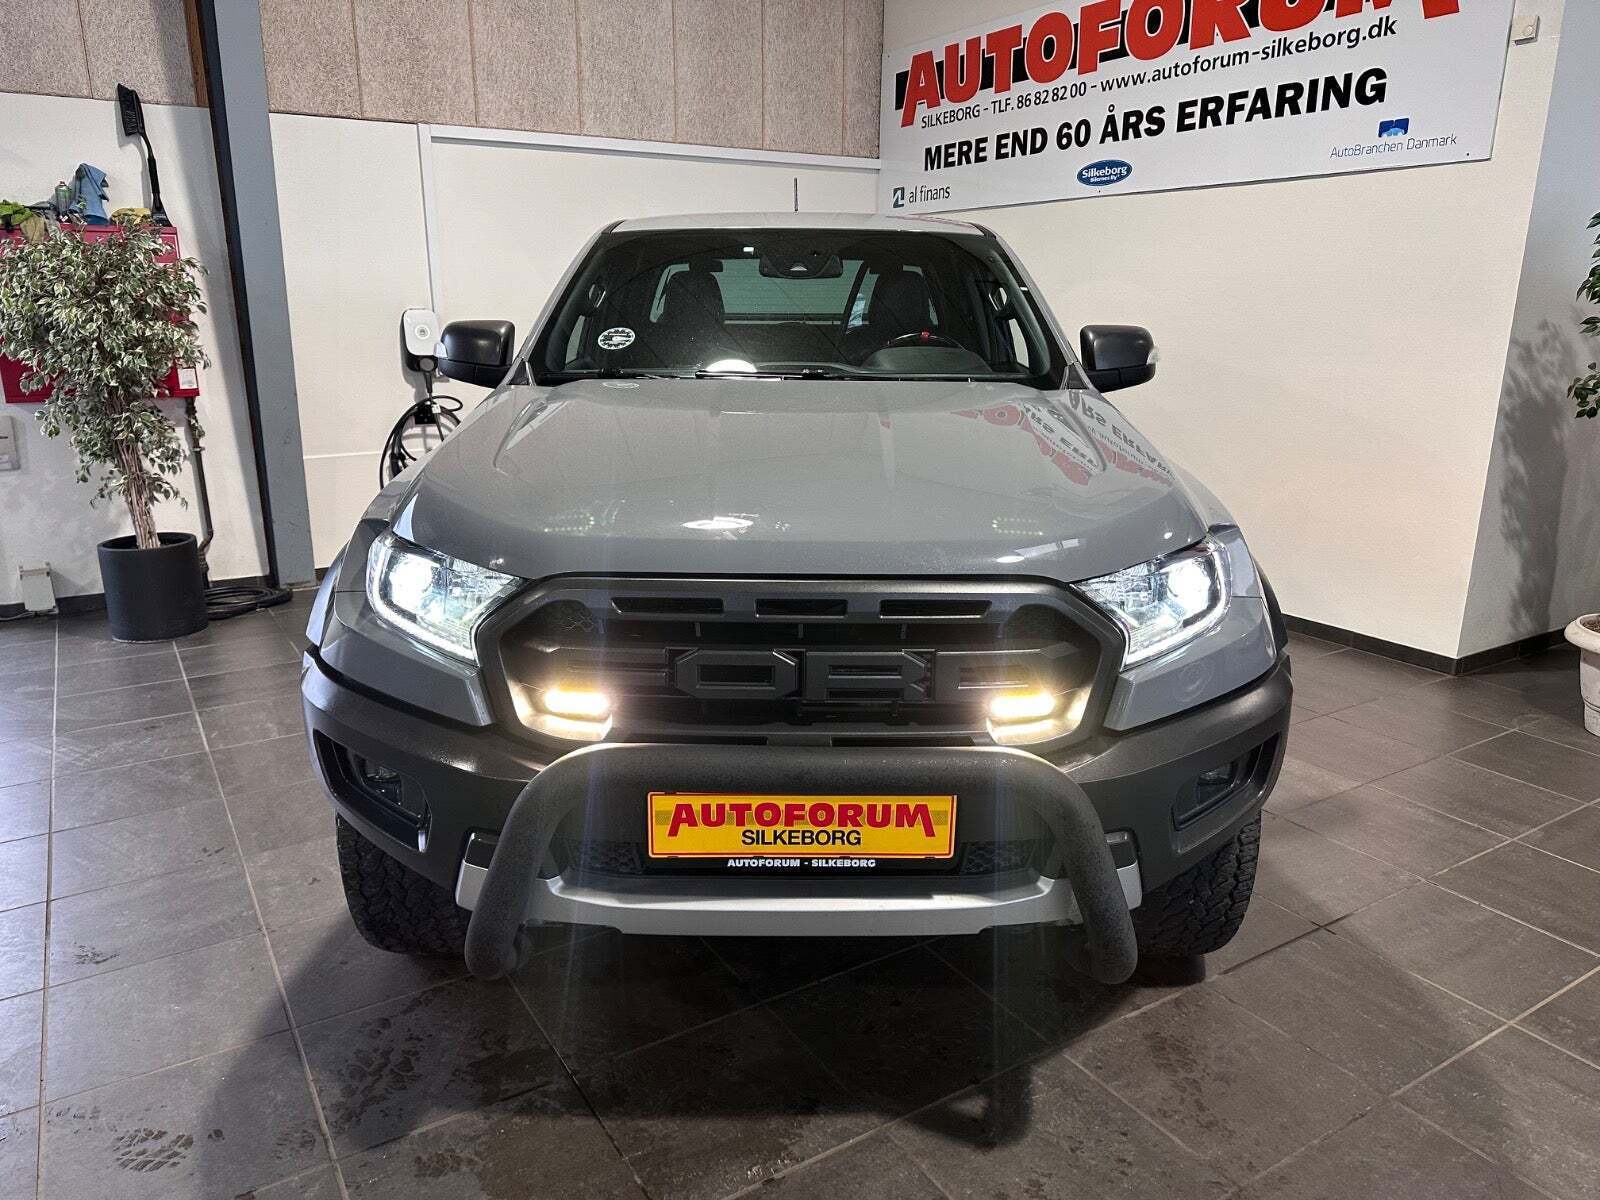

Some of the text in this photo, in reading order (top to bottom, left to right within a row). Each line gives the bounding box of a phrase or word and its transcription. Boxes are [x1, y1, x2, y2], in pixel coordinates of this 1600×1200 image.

[901, 0, 1460, 128] AUTOFOR
[921, 104, 981, 129] SILKEBORG
[991, 98, 1014, 115] TLF.
[1100, 15, 1398, 92] www.autoforum-silkeborg.dk
[924, 67, 1388, 172] MERE END 60 ÅRS ERFARING
[1330, 133, 1457, 159] AutoBranchen Danmark
[1082, 166, 1128, 179] Silkeborg
[920, 184, 951, 202] finans
[667, 802, 936, 838] AUTOFORUM
[741, 829, 862, 846] SILKEBORG
[727, 858, 801, 868] AUTOFORUM
[811, 858, 876, 868] SILKEBORG
